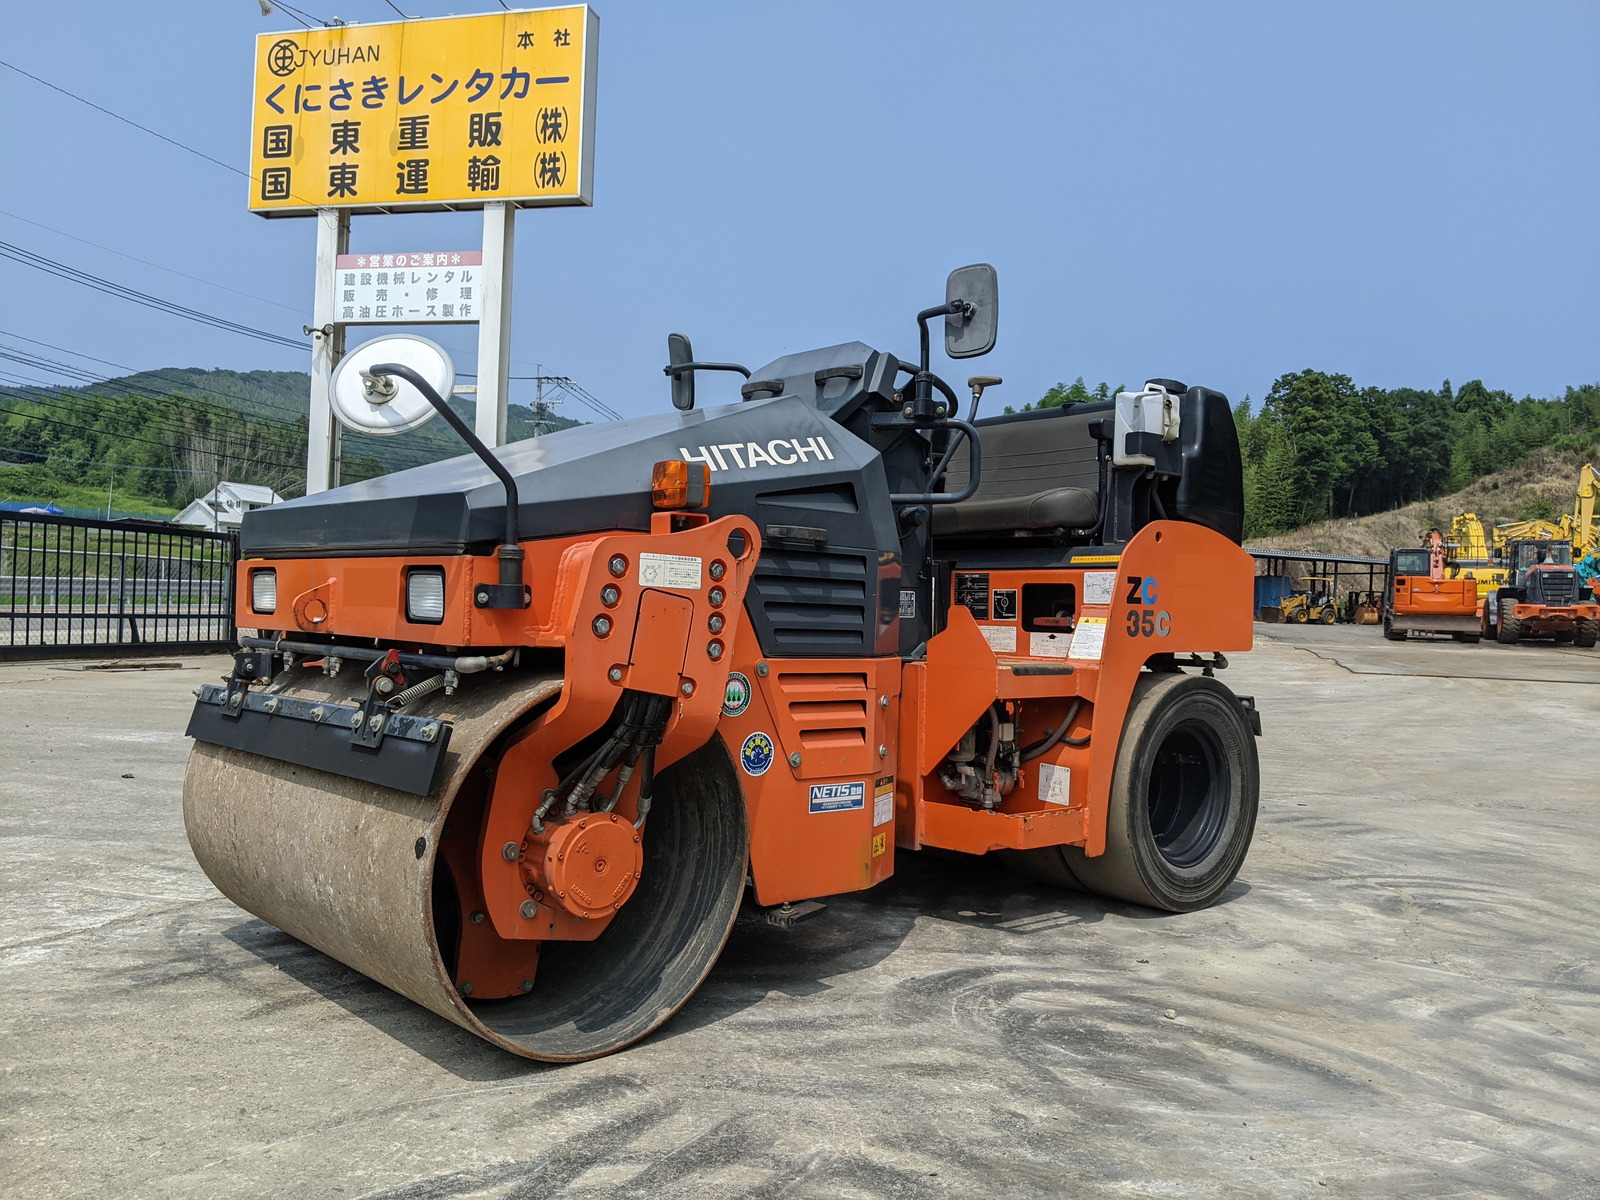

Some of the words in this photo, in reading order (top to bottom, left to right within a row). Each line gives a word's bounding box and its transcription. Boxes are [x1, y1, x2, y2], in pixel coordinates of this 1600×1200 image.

[517, 29, 571, 50] 本社
[294, 45, 381, 68] JYUHAN
[265, 67, 570, 115] くにさきレンタカー
[344, 270, 473, 286] 建設機械レンタル
[342, 303, 472, 319] 高油圧ホース製作
[679, 435, 835, 472] HITACHI
[1126, 575, 1159, 606] ZC
[1126, 609, 1171, 638] 35C
[812, 784, 850, 799] NETIS
